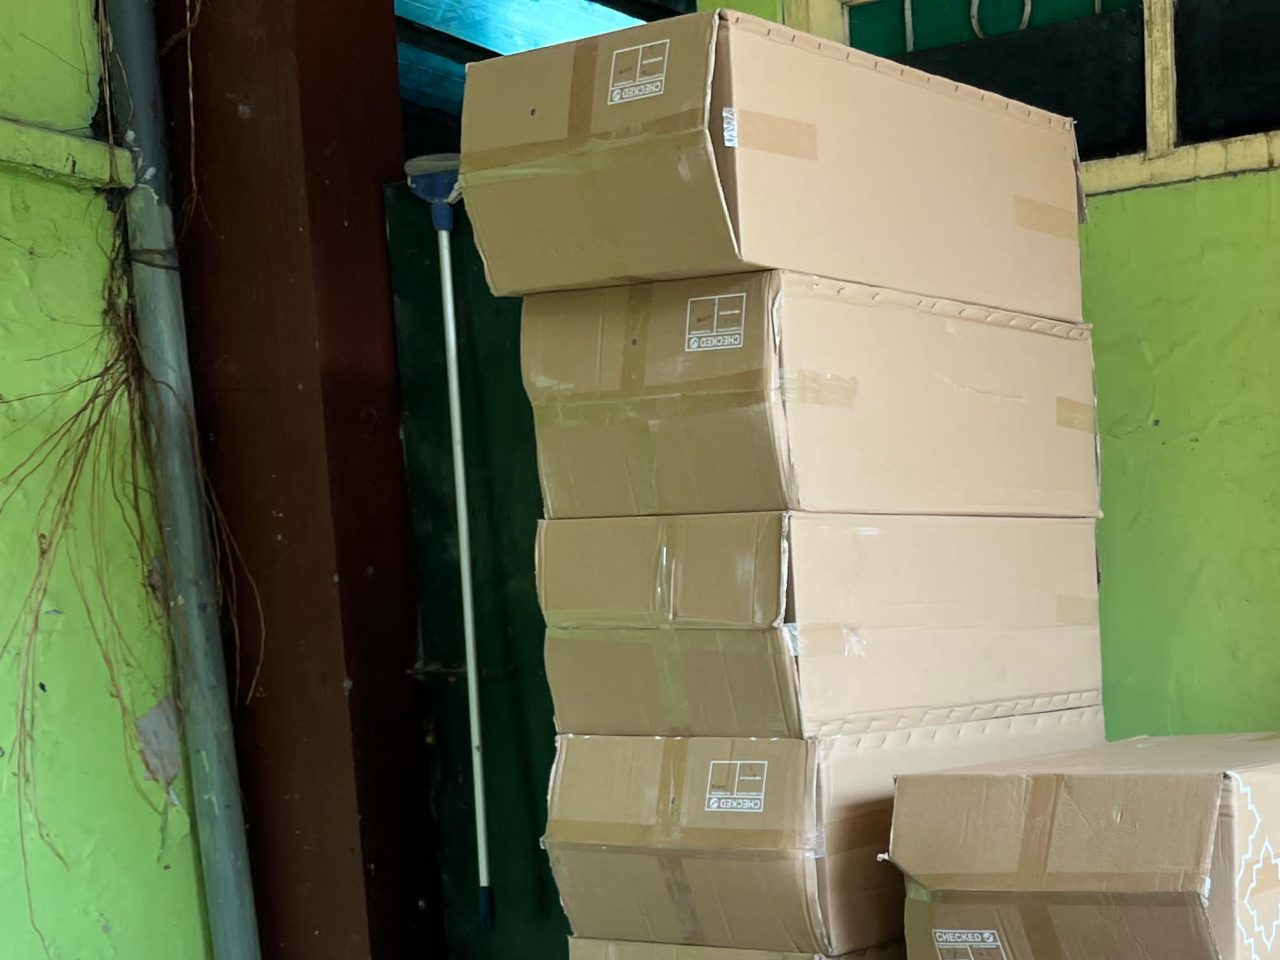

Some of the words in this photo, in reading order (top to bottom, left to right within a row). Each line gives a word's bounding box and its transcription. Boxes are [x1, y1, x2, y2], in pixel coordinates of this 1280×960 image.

[622, 81, 661, 98] CHECKED
[700, 334, 740, 347] CHECKED
[720, 798, 761, 809] CHECKED
[935, 932, 982, 942] CHECKED
